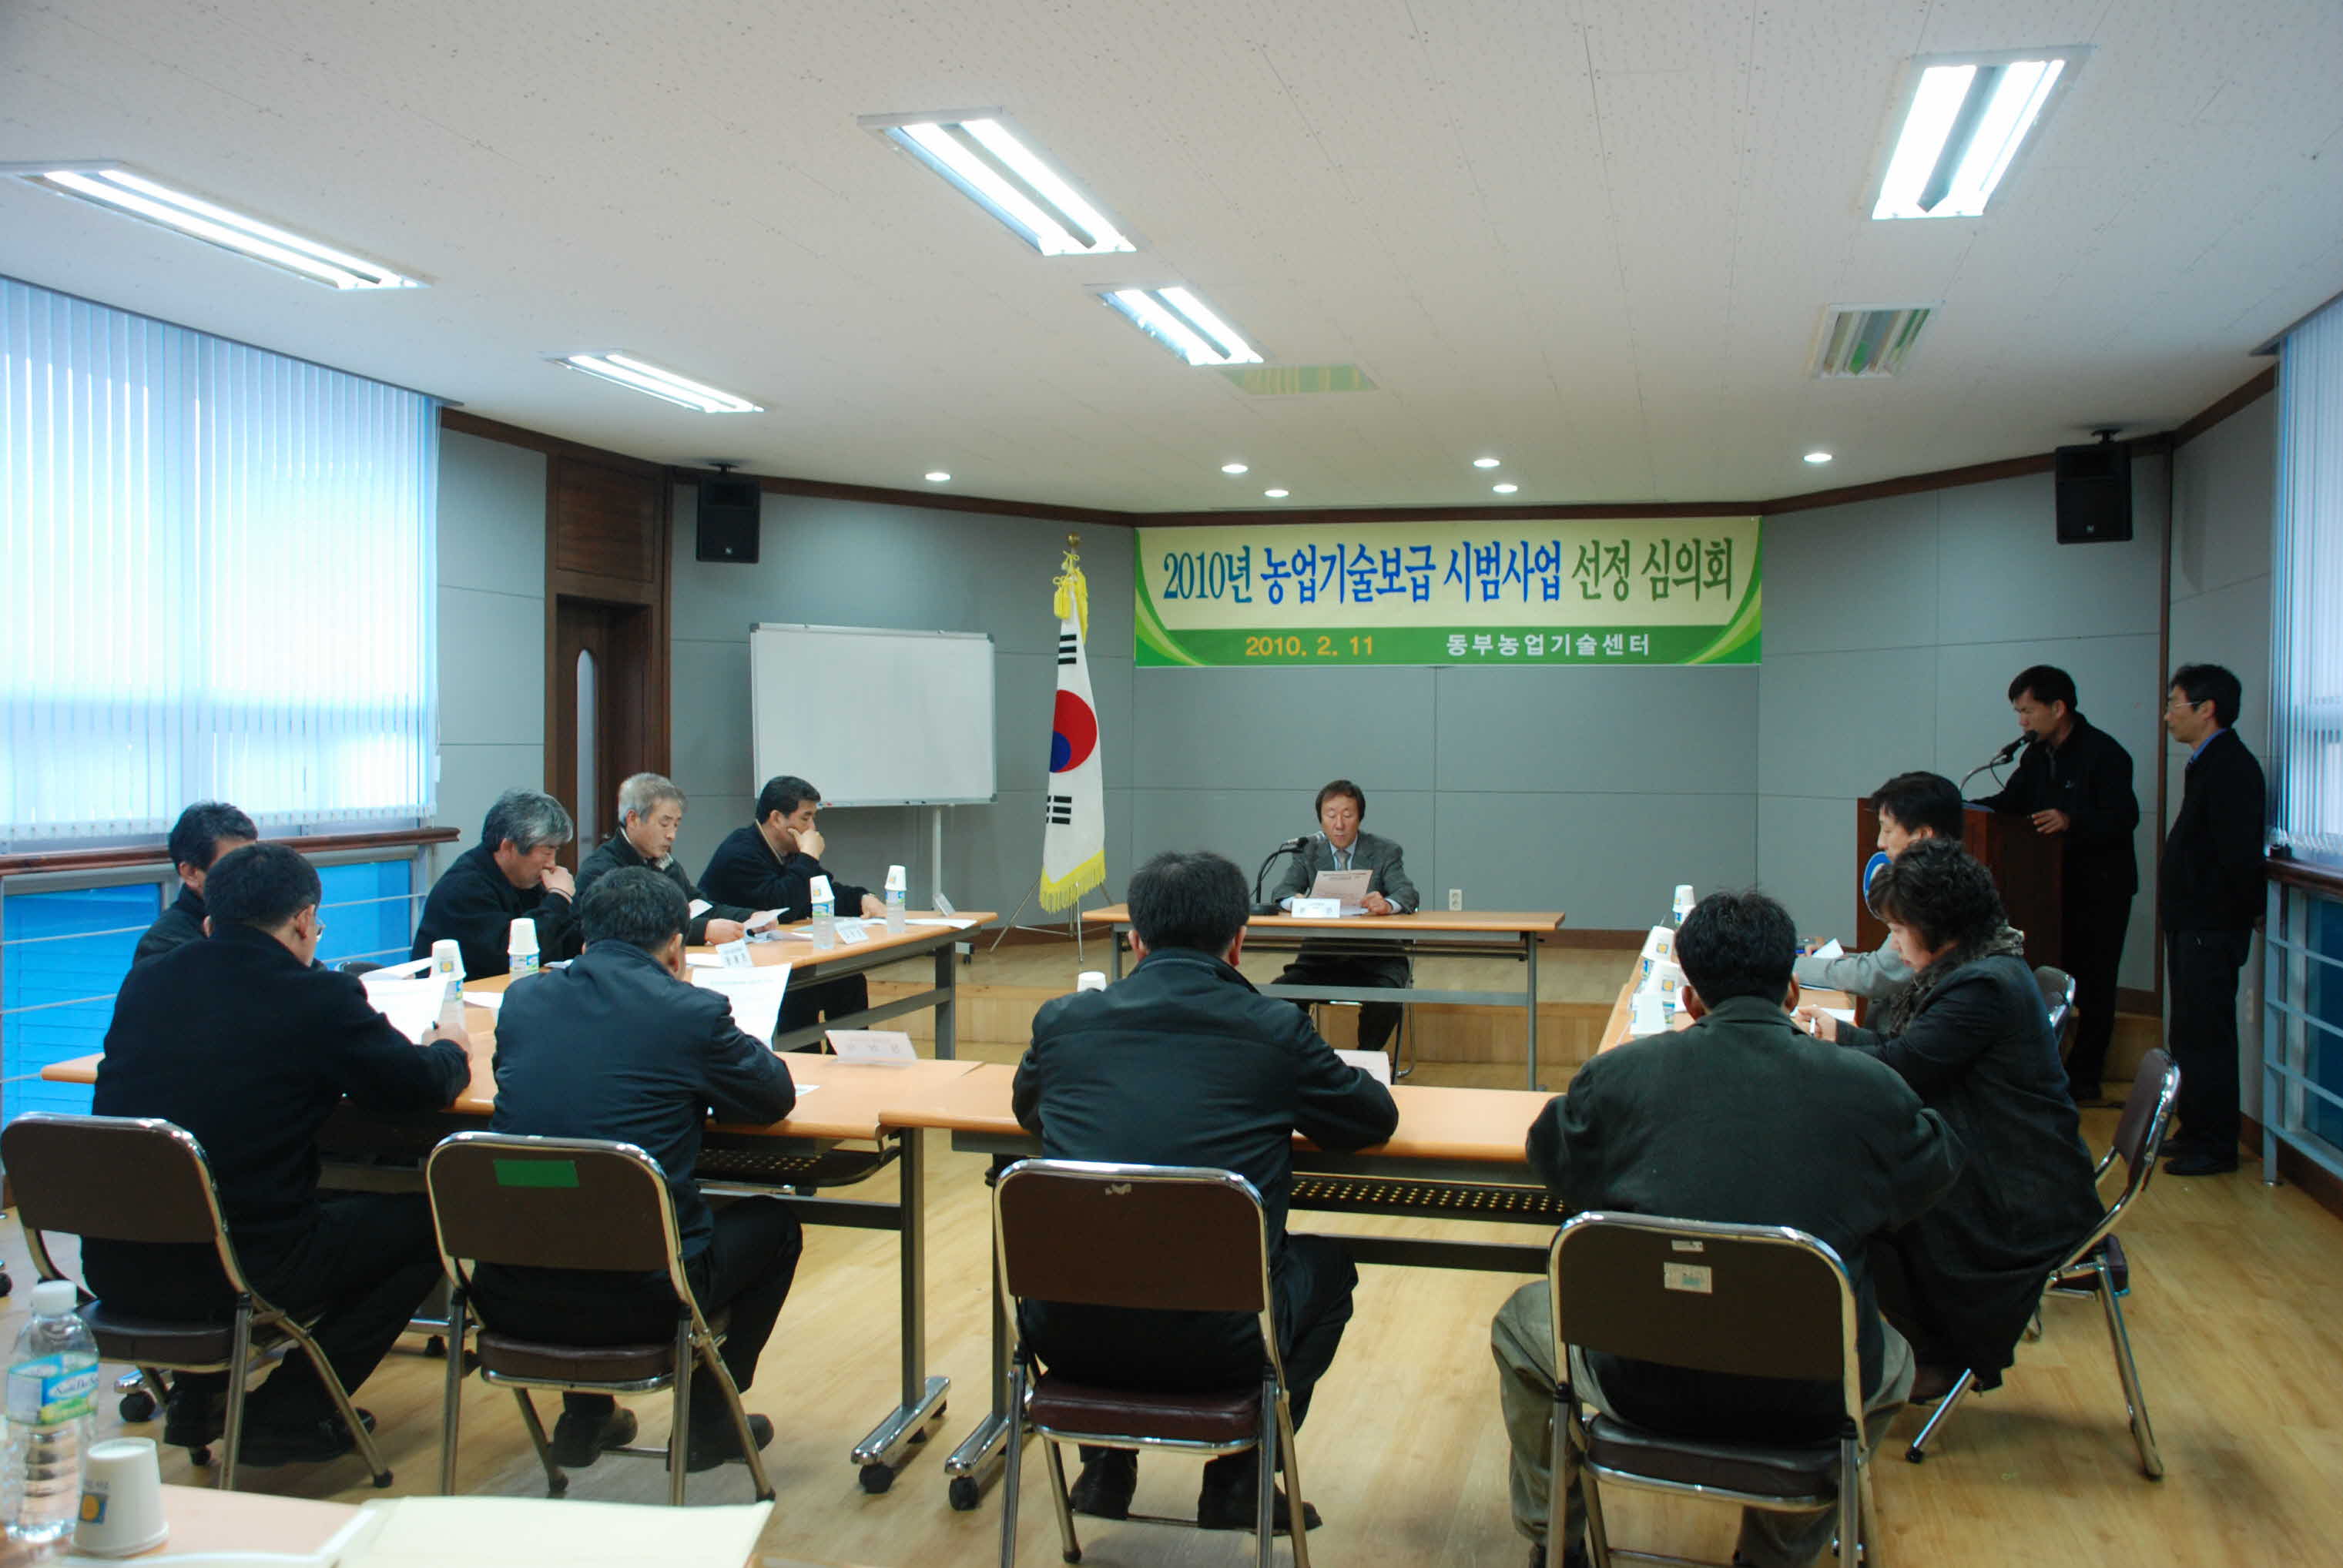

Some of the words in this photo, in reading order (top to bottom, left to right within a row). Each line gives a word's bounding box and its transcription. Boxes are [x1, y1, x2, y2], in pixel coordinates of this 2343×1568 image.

[1163, 544, 1252, 604] 2010년
[1260, 542, 1436, 605] 농업기술보급
[1443, 539, 1561, 603] 시범사업
[1570, 539, 1631, 601] 선정
[1641, 537, 1732, 602] 심의회
[1245, 635, 1307, 657] 2010.
[1317, 635, 1339, 657] 2.
[1349, 635, 1373, 656] 11
[1446, 633, 1650, 657] 동부농업기술센터
